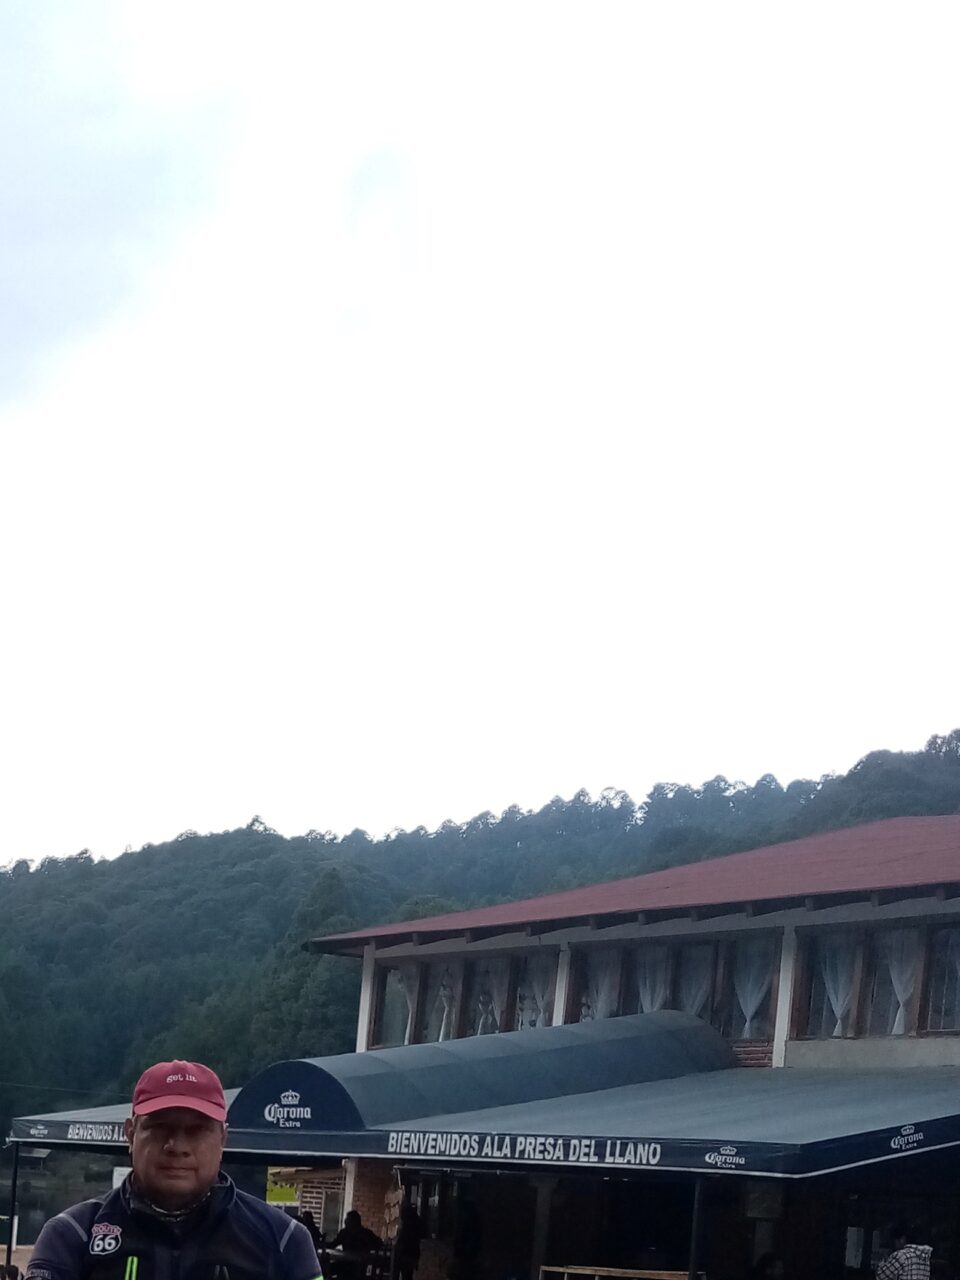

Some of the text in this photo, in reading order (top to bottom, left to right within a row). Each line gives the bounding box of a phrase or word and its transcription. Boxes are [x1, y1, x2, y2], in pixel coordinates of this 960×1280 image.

[263, 1102, 311, 1123] Corona
[279, 1118, 301, 1128] Extra
[67, 1124, 113, 1141] BIENVENIDOS
[890, 1131, 924, 1150] Corona
[388, 1132, 479, 1157] BIENVENIDOS
[514, 1136, 565, 1161] PRESA
[568, 1139, 599, 1163] DEL
[605, 1139, 661, 1165] LLANO
[704, 1151, 746, 1165] Corona
[93, 1234, 117, 1252] 66
